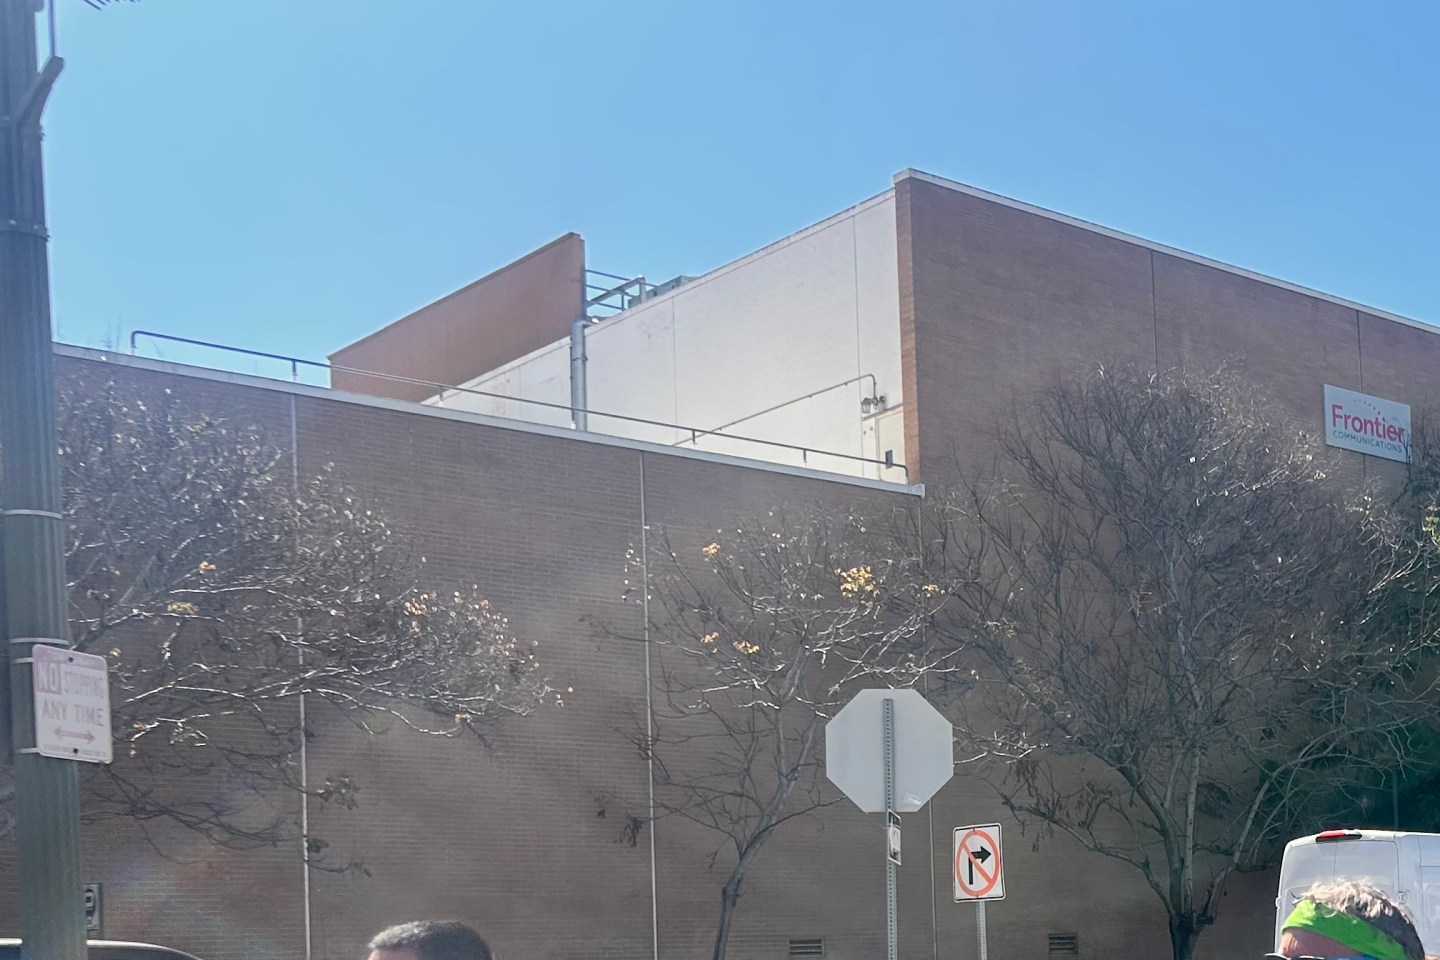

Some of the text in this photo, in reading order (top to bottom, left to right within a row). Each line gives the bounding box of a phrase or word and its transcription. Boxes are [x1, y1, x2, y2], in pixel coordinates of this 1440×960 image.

[1332, 403, 1405, 443] Frontier
[1333, 430, 1402, 453] COMMUNICATIONS
[37, 660, 61, 695] NO
[42, 698, 105, 727] ANY TIME
